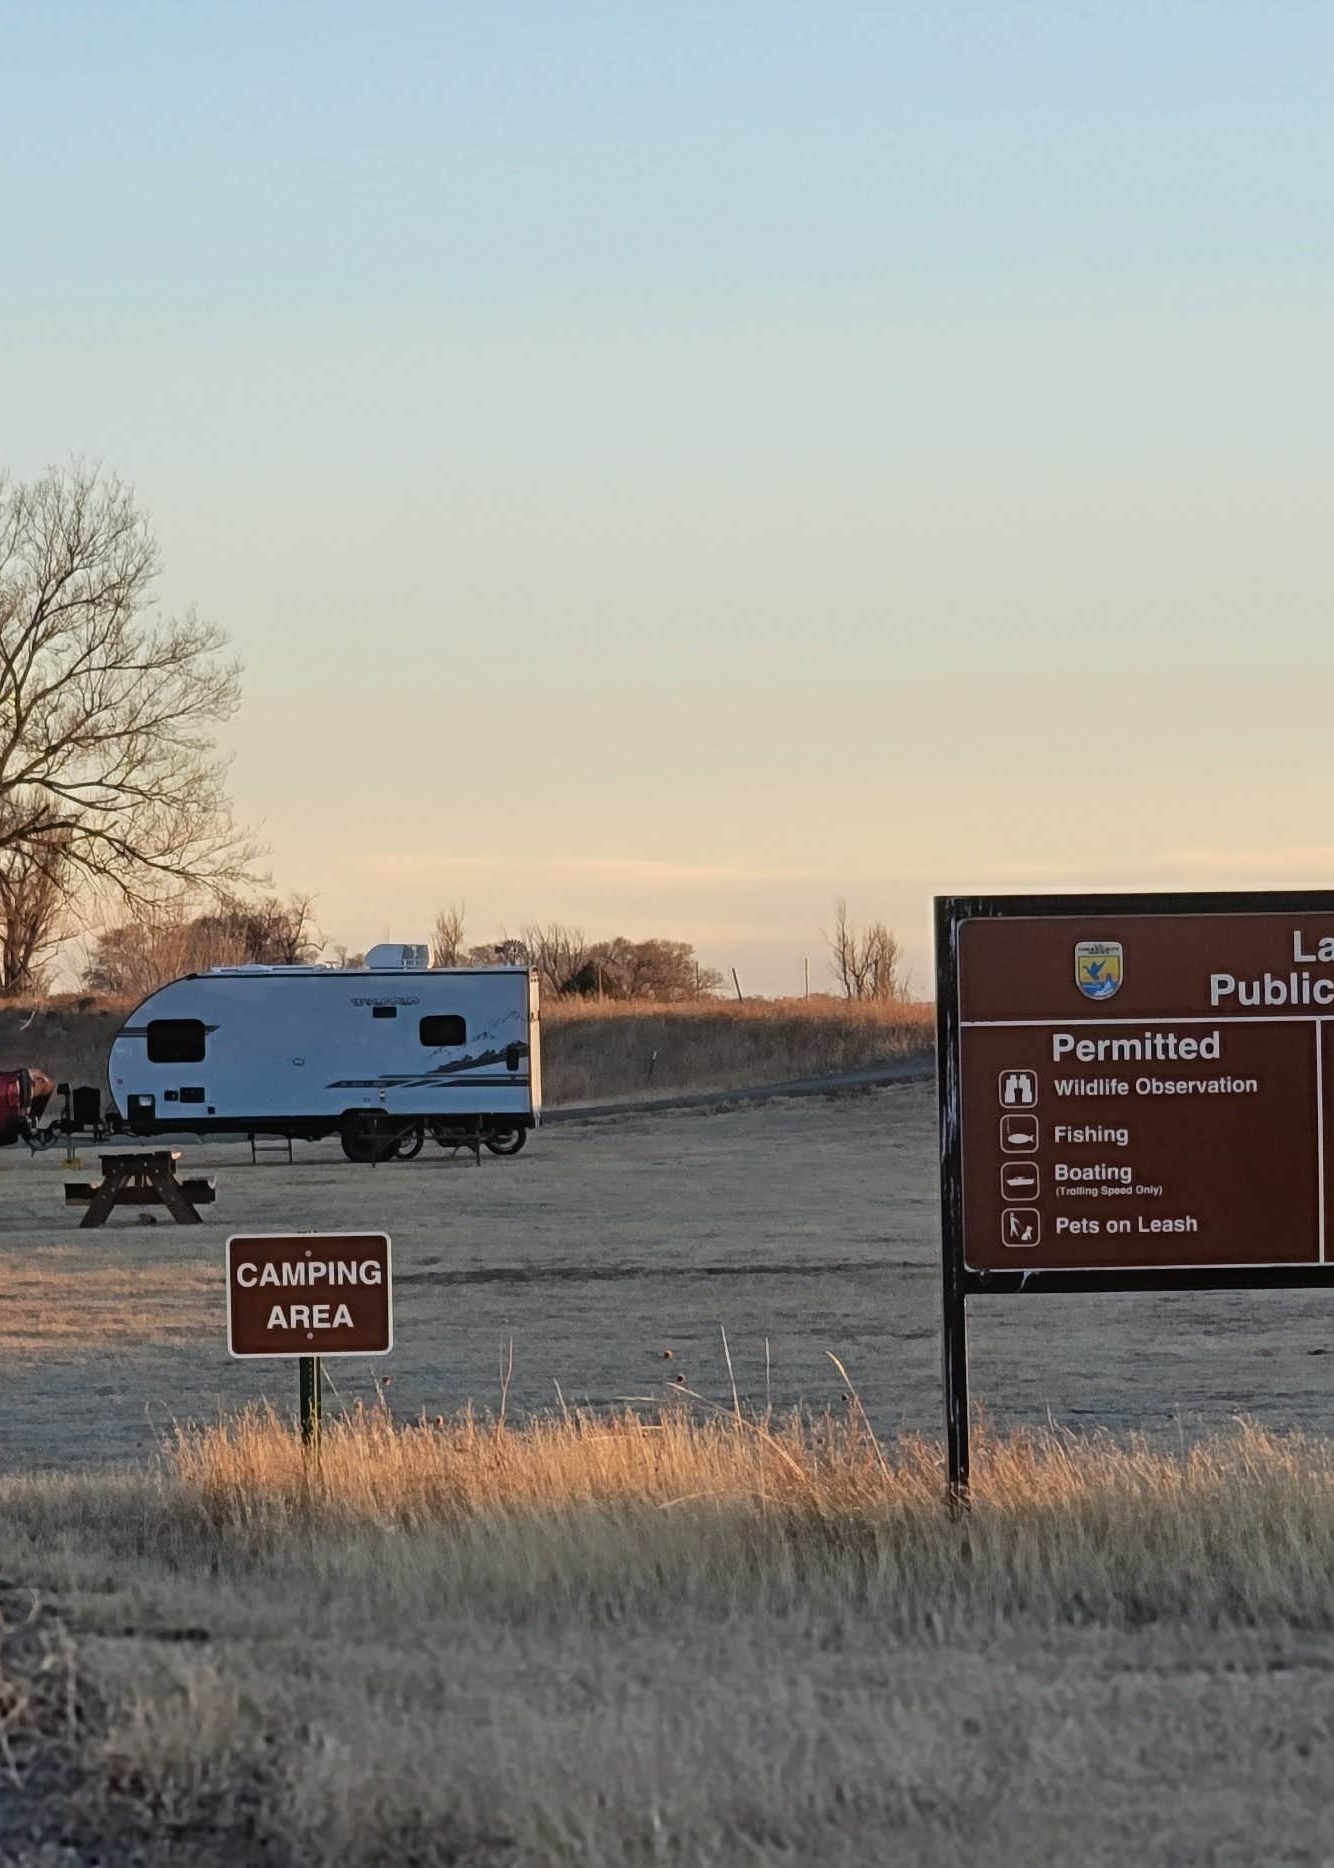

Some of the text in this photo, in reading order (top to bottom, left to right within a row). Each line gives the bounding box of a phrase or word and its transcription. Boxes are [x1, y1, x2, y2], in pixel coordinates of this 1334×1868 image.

[1211, 972, 1334, 1006] Public
[1053, 1031, 1219, 1061] Permitted
[1054, 1076, 1257, 1096] Wildlife Observation
[1055, 1126, 1128, 1146] Fishing
[1055, 1164, 1131, 1184] Boating
[1055, 1185, 1163, 1198] (Trolling Speed Only)
[1057, 1216, 1197, 1233] Pets on Leash
[237, 1260, 381, 1287] CAMPING
[267, 1304, 354, 1329] AREA
